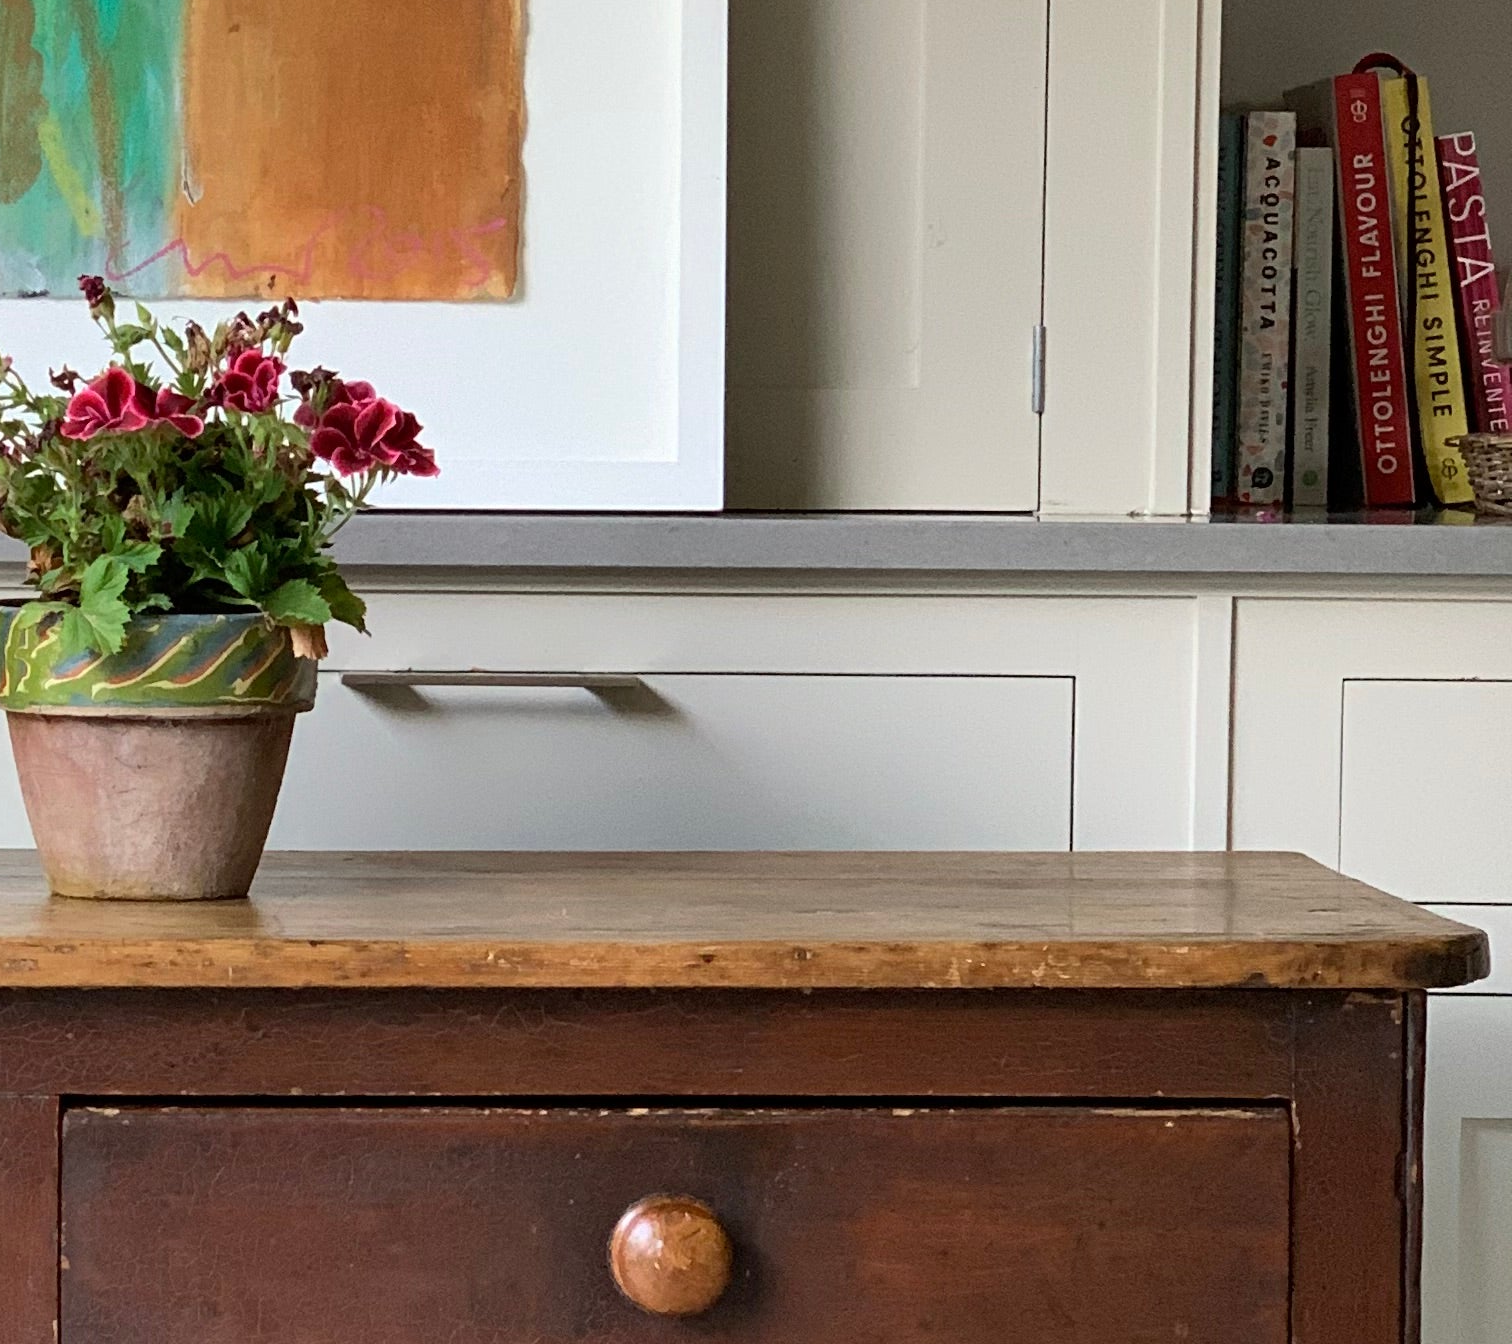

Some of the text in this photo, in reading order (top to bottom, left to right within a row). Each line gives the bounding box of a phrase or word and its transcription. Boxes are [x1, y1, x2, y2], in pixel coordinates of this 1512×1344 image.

[1259, 157, 1281, 329] ACQUACOTTA
[1353, 153, 1398, 474] OTTOLENGHI FLAVOUR
[1439, 130, 1510, 432] PASTA REINVENTE
[1423, 317, 1453, 417] SIMPLE
